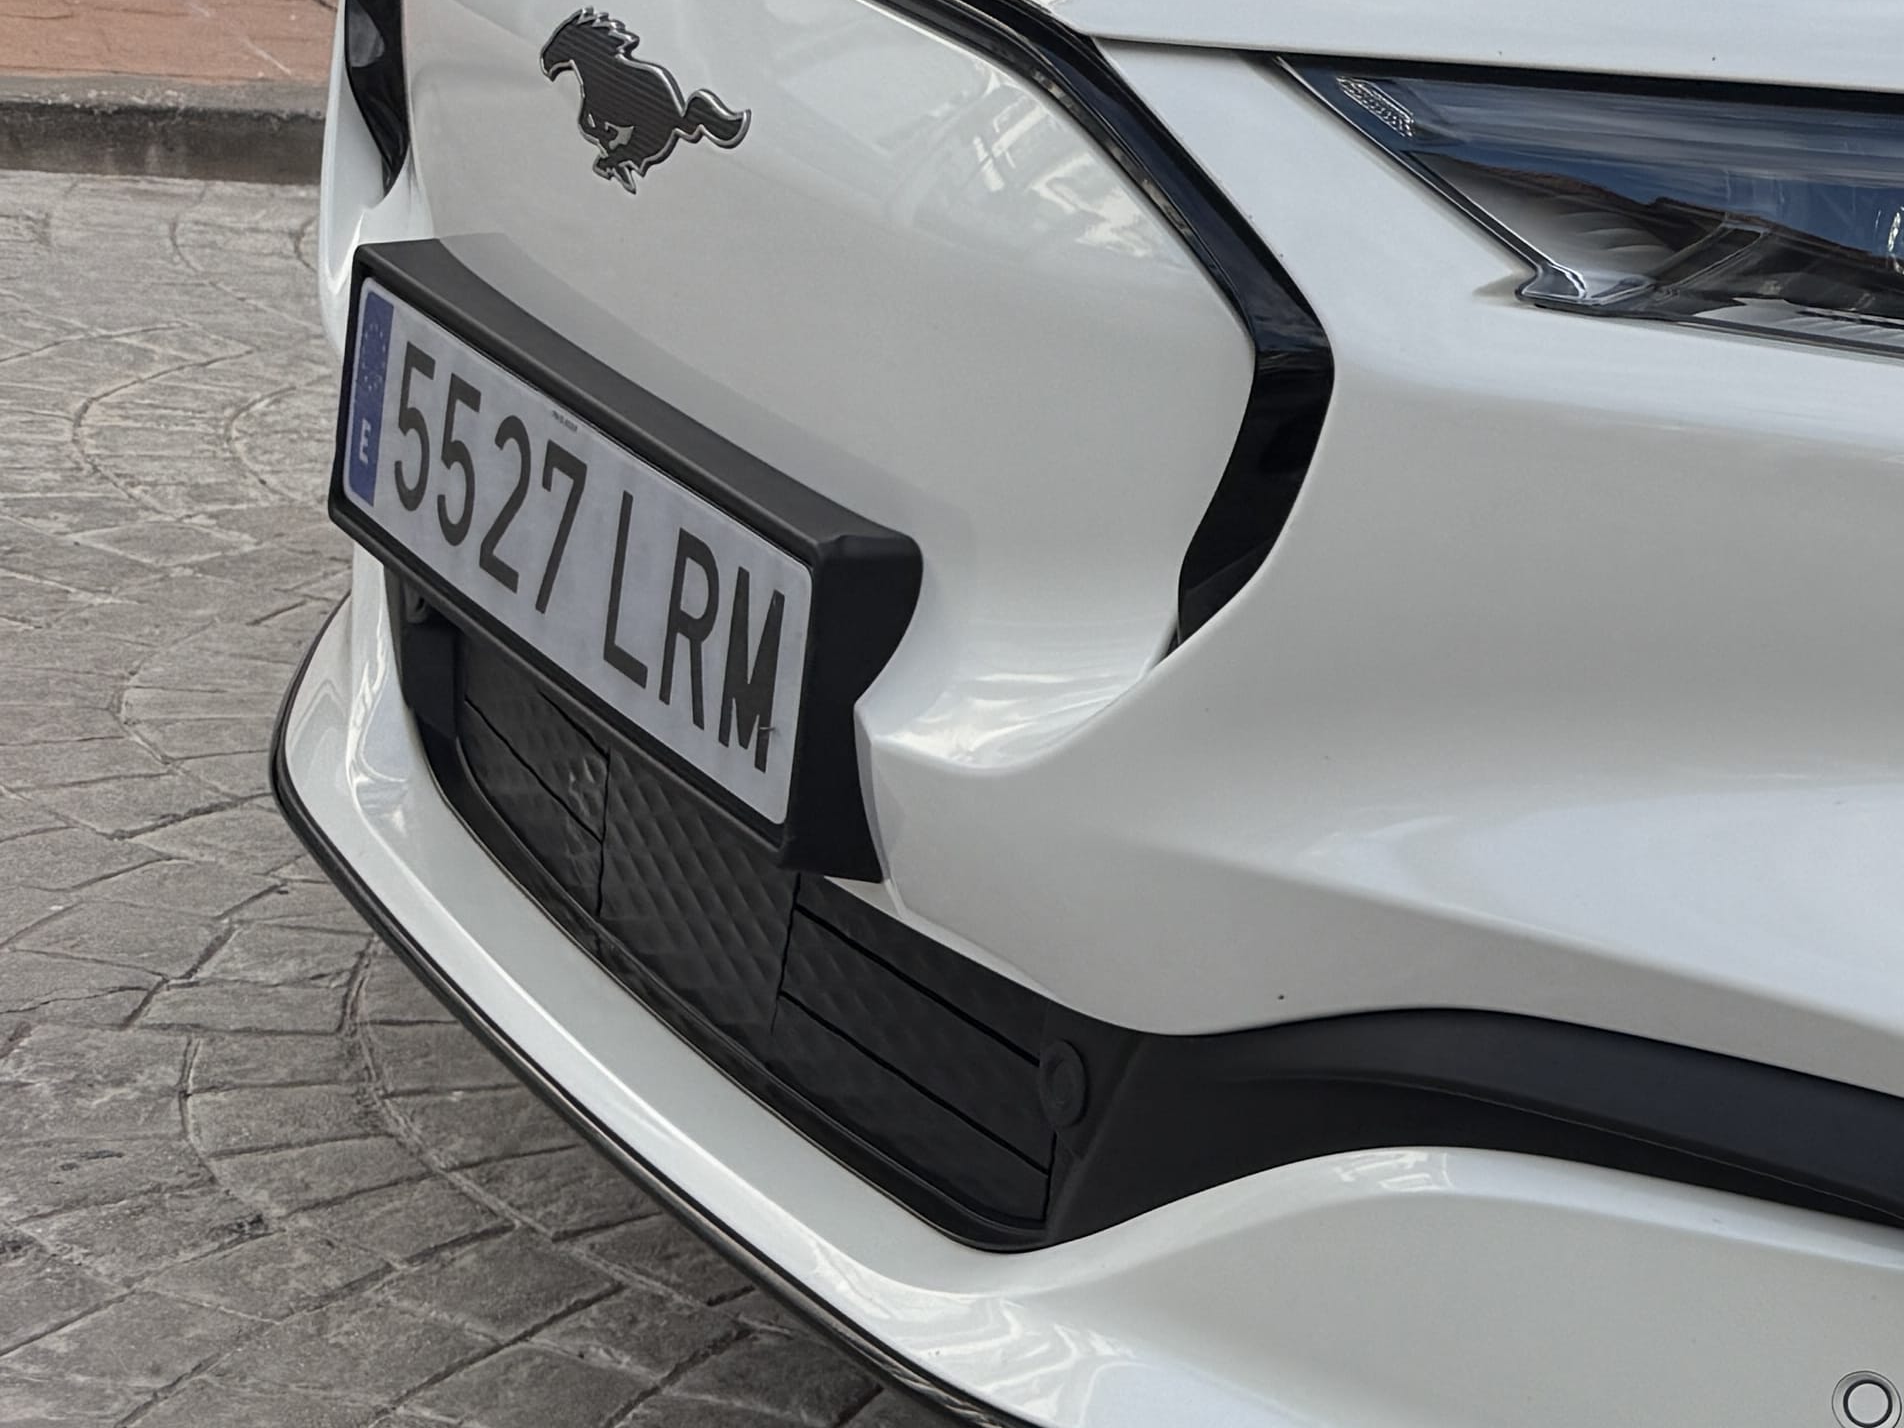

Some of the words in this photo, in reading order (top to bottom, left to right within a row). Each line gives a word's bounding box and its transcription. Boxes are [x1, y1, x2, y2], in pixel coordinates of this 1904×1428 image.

[359, 418, 371, 465] E
[394, 341, 587, 614] 5527
[603, 490, 784, 773] LRM
